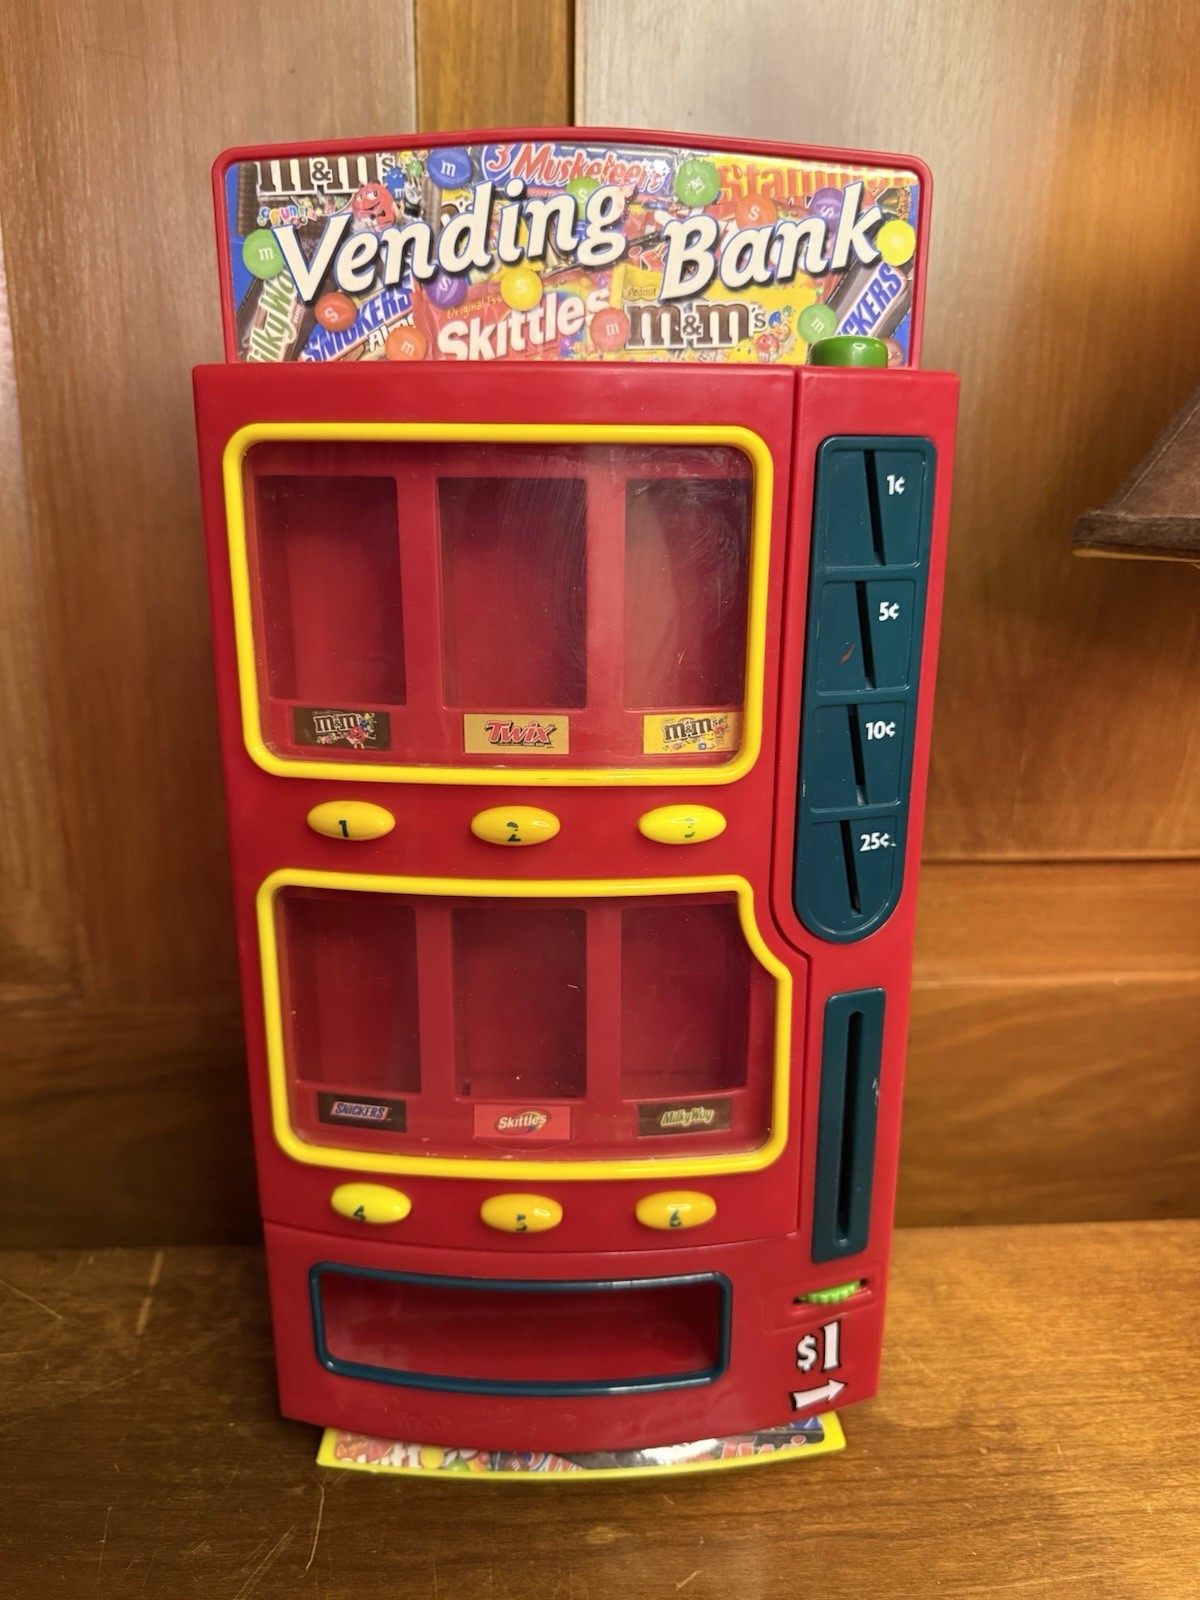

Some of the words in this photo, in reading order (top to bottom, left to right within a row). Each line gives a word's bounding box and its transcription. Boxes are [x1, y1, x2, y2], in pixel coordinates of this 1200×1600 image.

[441, 160, 457, 177] m
[271, 177, 637, 303] Vending
[659, 181, 884, 301] Bank
[258, 247, 274, 261] m
[627, 286, 657, 297] Peanut
[839, 261, 902, 335] CKERS
[437, 288, 610, 361] Skittles
[605, 321, 619, 335] m
[810, 318, 825, 334] m
[400, 341, 415, 357] m
[886, 474, 905, 496] 1¢
[878, 601, 900, 622] 5¢
[485, 719, 555, 744] Twix
[865, 720, 896, 741] 10¢
[338, 819, 349, 838] 1
[506, 821, 522, 842] 2
[334, 1102, 386, 1119] SNICKERS
[497, 1113, 548, 1130] Skittles
[353, 1205, 366, 1221] 4
[669, 1208, 683, 1228] 6
[796, 1319, 842, 1374] $1
